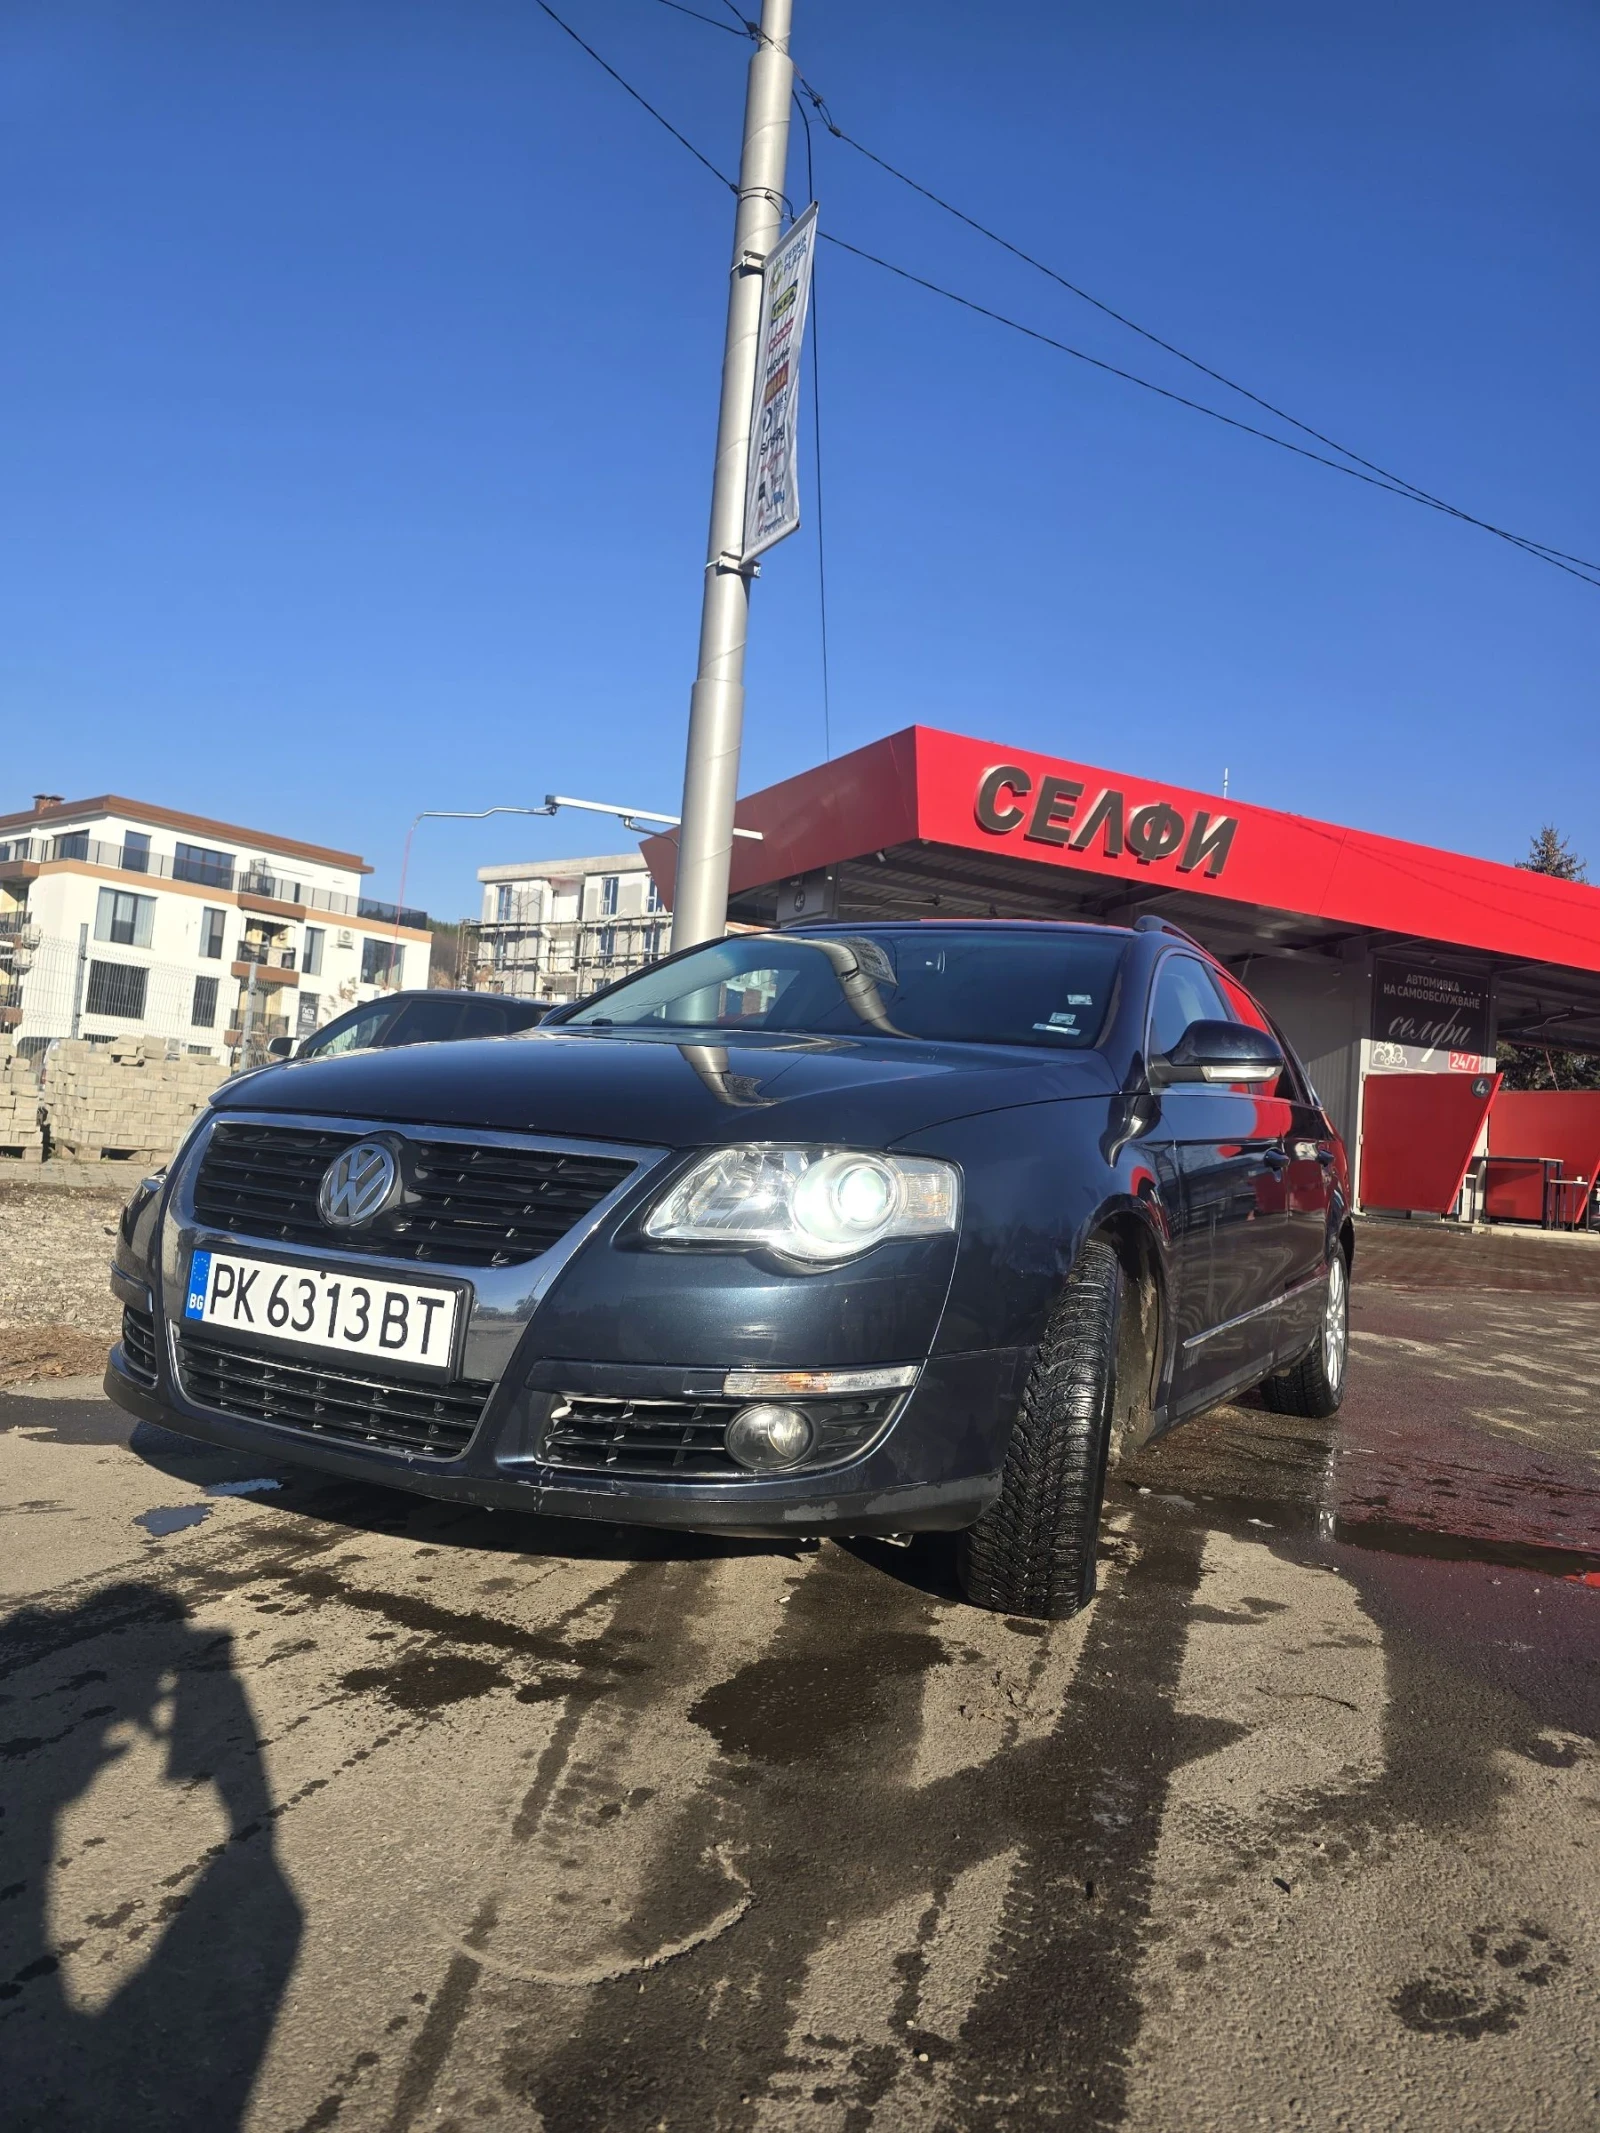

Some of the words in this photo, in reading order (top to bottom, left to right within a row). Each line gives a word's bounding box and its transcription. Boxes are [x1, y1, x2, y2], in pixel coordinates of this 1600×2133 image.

[974, 764, 1239, 879] СЕЛФИ
[1406, 974, 1460, 992] АВТОМИВКА
[1383, 983, 1397, 995] НА
[1397, 985, 1480, 1009] САМООБСЛУЖВАНЕ
[1451, 1053, 1477, 1070] 24/7
[188, 1293, 204, 1311] BG
